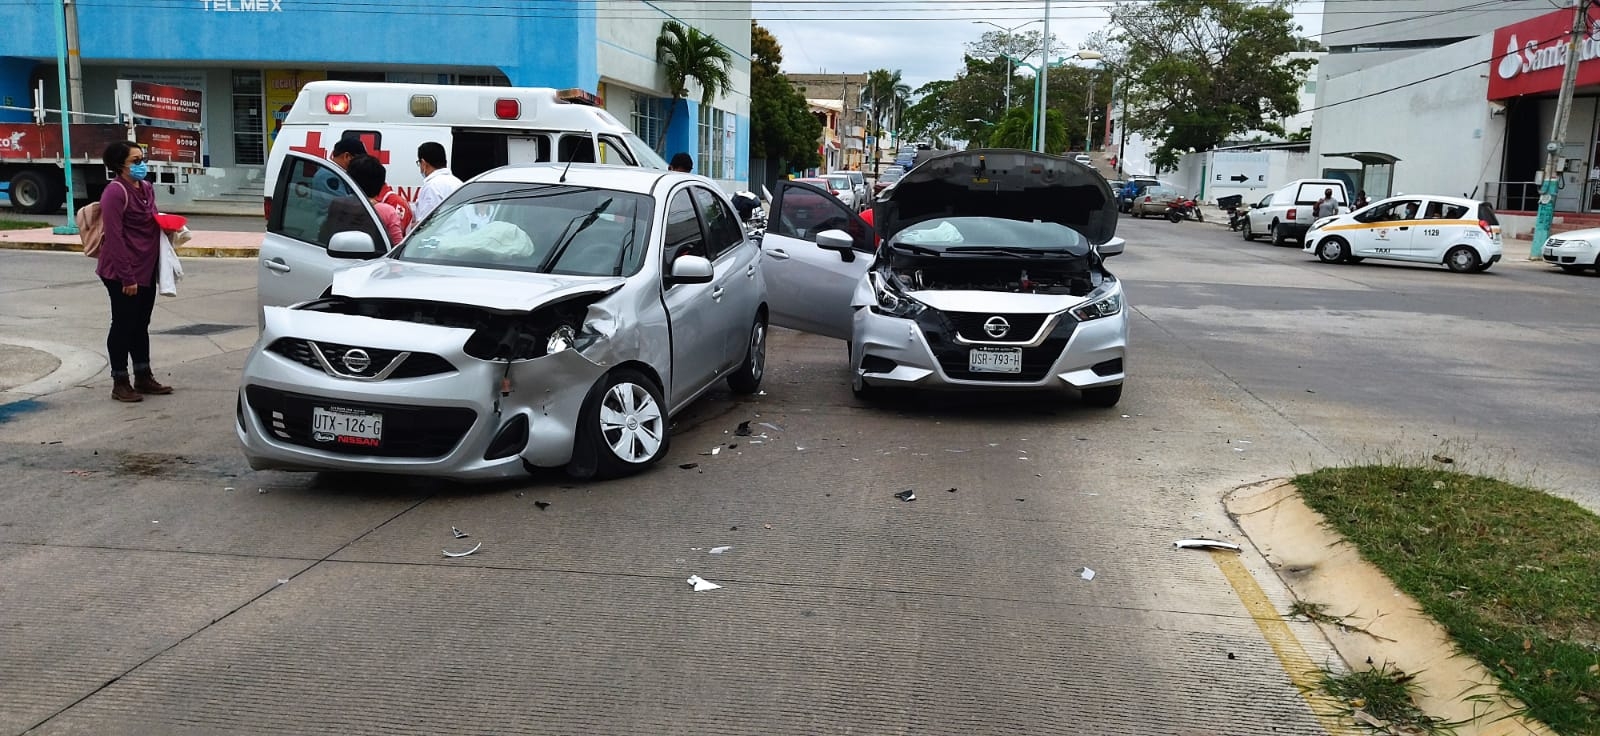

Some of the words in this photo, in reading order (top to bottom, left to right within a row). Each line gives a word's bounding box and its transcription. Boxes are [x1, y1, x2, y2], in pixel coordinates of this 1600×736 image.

[200, 0, 283, 12] TELMEX
[1522, 20, 1600, 73] Santad
[971, 353, 1020, 366] USR-793-H
[314, 413, 381, 435] UTX-126-G
[337, 434, 380, 447] NISSAN
